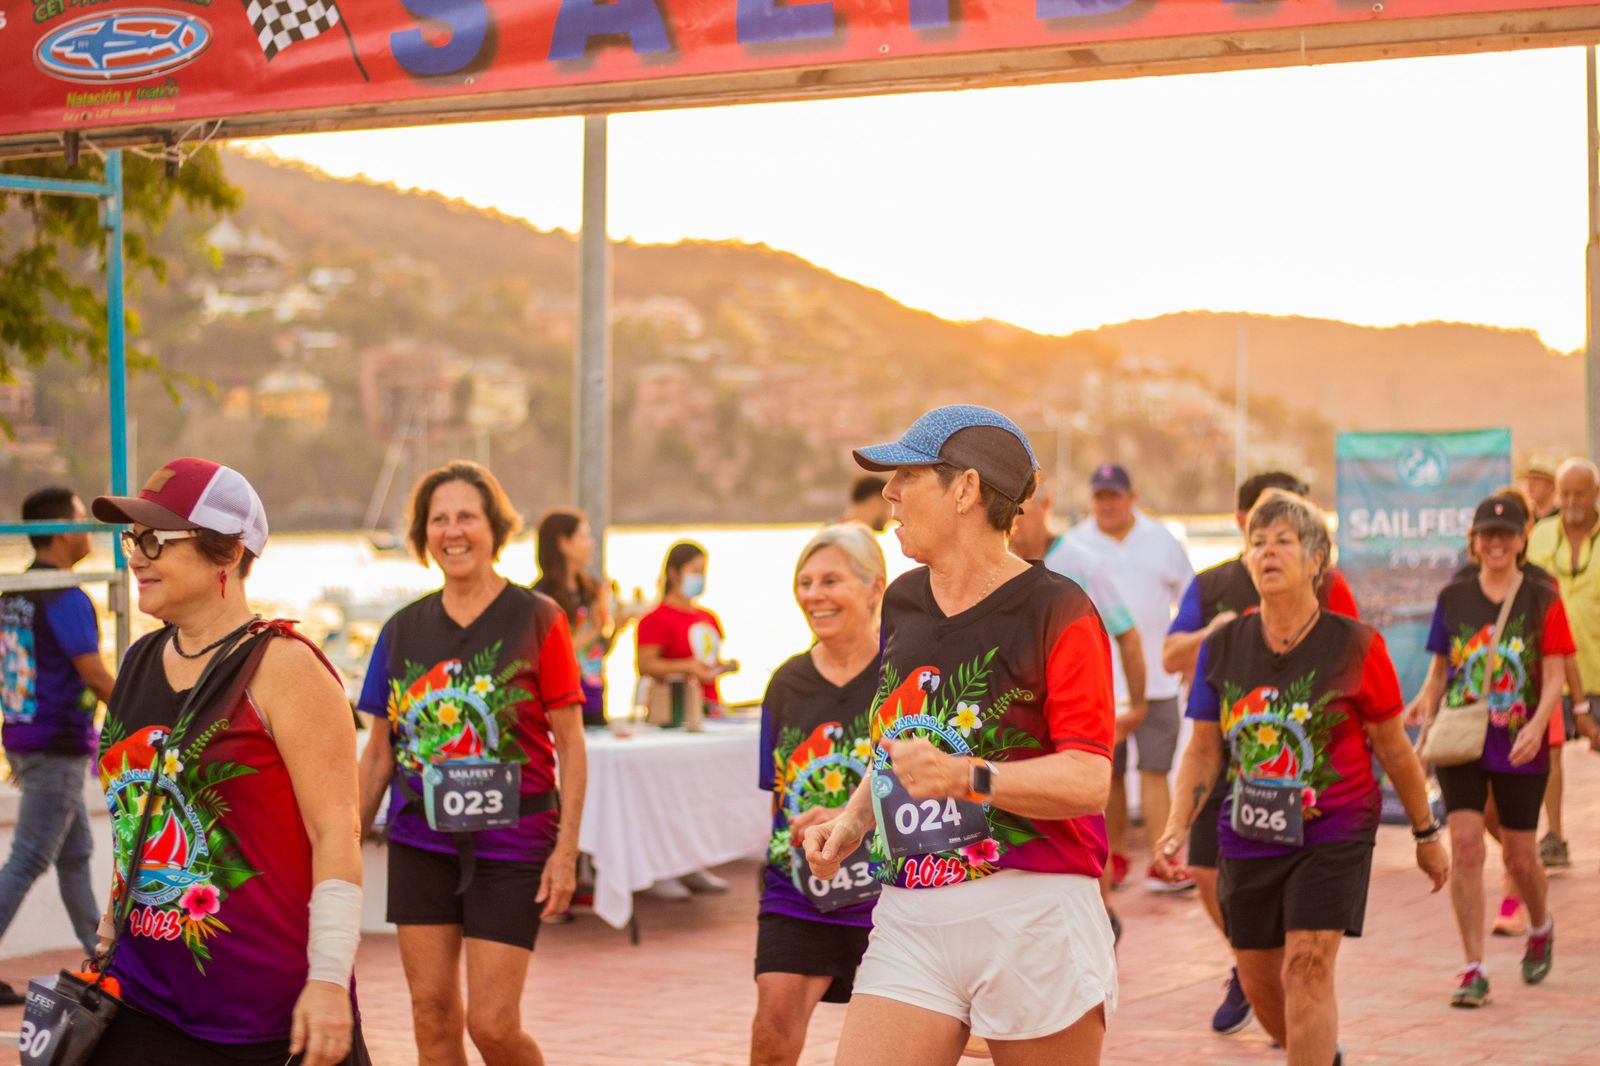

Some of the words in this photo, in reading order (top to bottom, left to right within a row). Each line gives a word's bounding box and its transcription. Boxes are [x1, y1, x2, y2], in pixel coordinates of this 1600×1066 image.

[1350, 508, 1473, 539] SAILFES
[893, 714, 938, 731] PARAISO
[943, 725, 970, 753] ZIHU
[121, 768, 156, 783] PARAI
[443, 789, 503, 816] 023
[894, 796, 962, 835] 024
[1241, 804, 1288, 832] 026
[808, 861, 873, 897] 043
[904, 854, 967, 889] 2023
[130, 906, 183, 940] 2023
